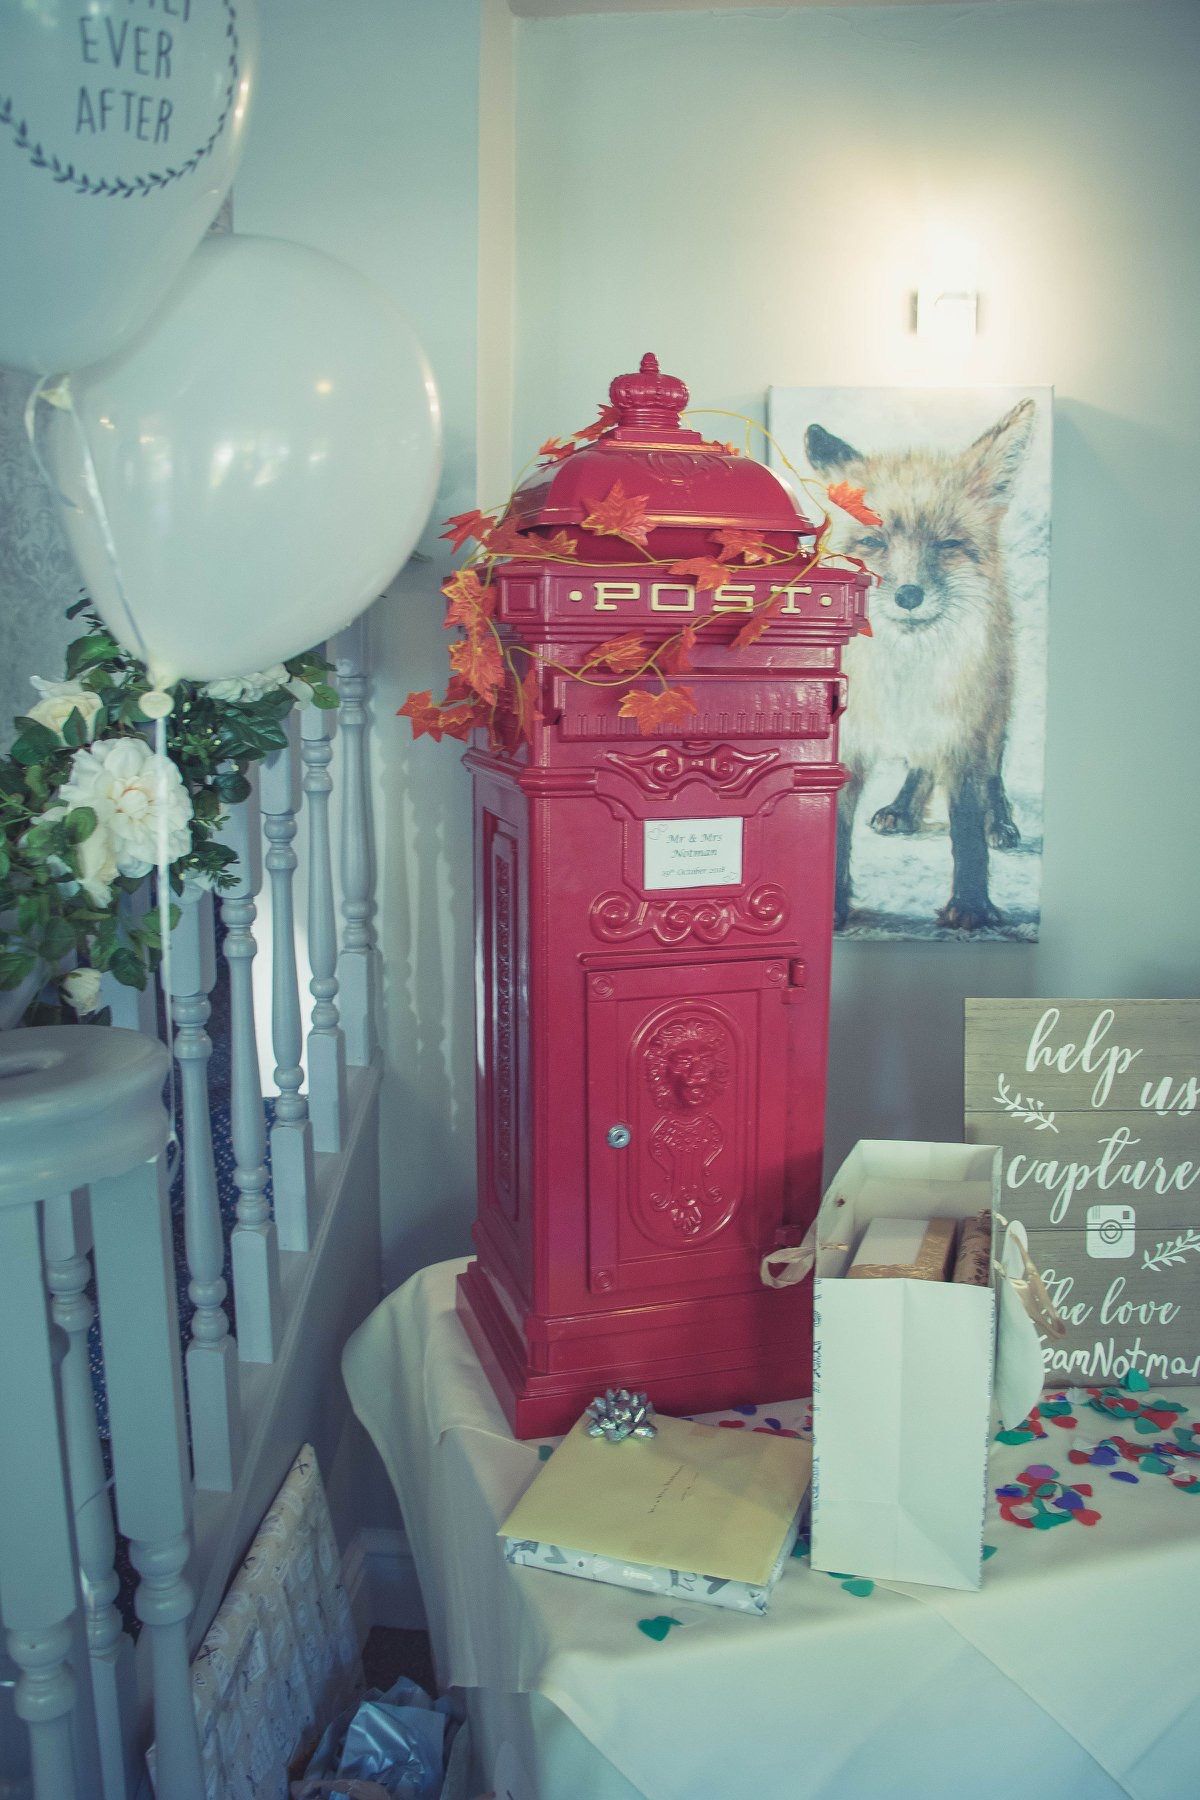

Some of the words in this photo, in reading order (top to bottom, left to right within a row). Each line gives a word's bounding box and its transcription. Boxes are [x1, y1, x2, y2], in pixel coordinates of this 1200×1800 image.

[79, 16, 173, 79] EVER
[75, 85, 174, 144] AFTER
[593, 582, 812, 614] POST
[666, 834, 686, 844] Mr
[689, 833, 698, 843] &
[700, 833, 723, 843] Mrs
[1025, 1008, 1143, 1107] help
[1140, 1076, 1200, 1115] us
[1006, 1127, 1200, 1223] capture
[1100, 1276, 1181, 1325] love
[1038, 1336, 1200, 1379] eamNotma
